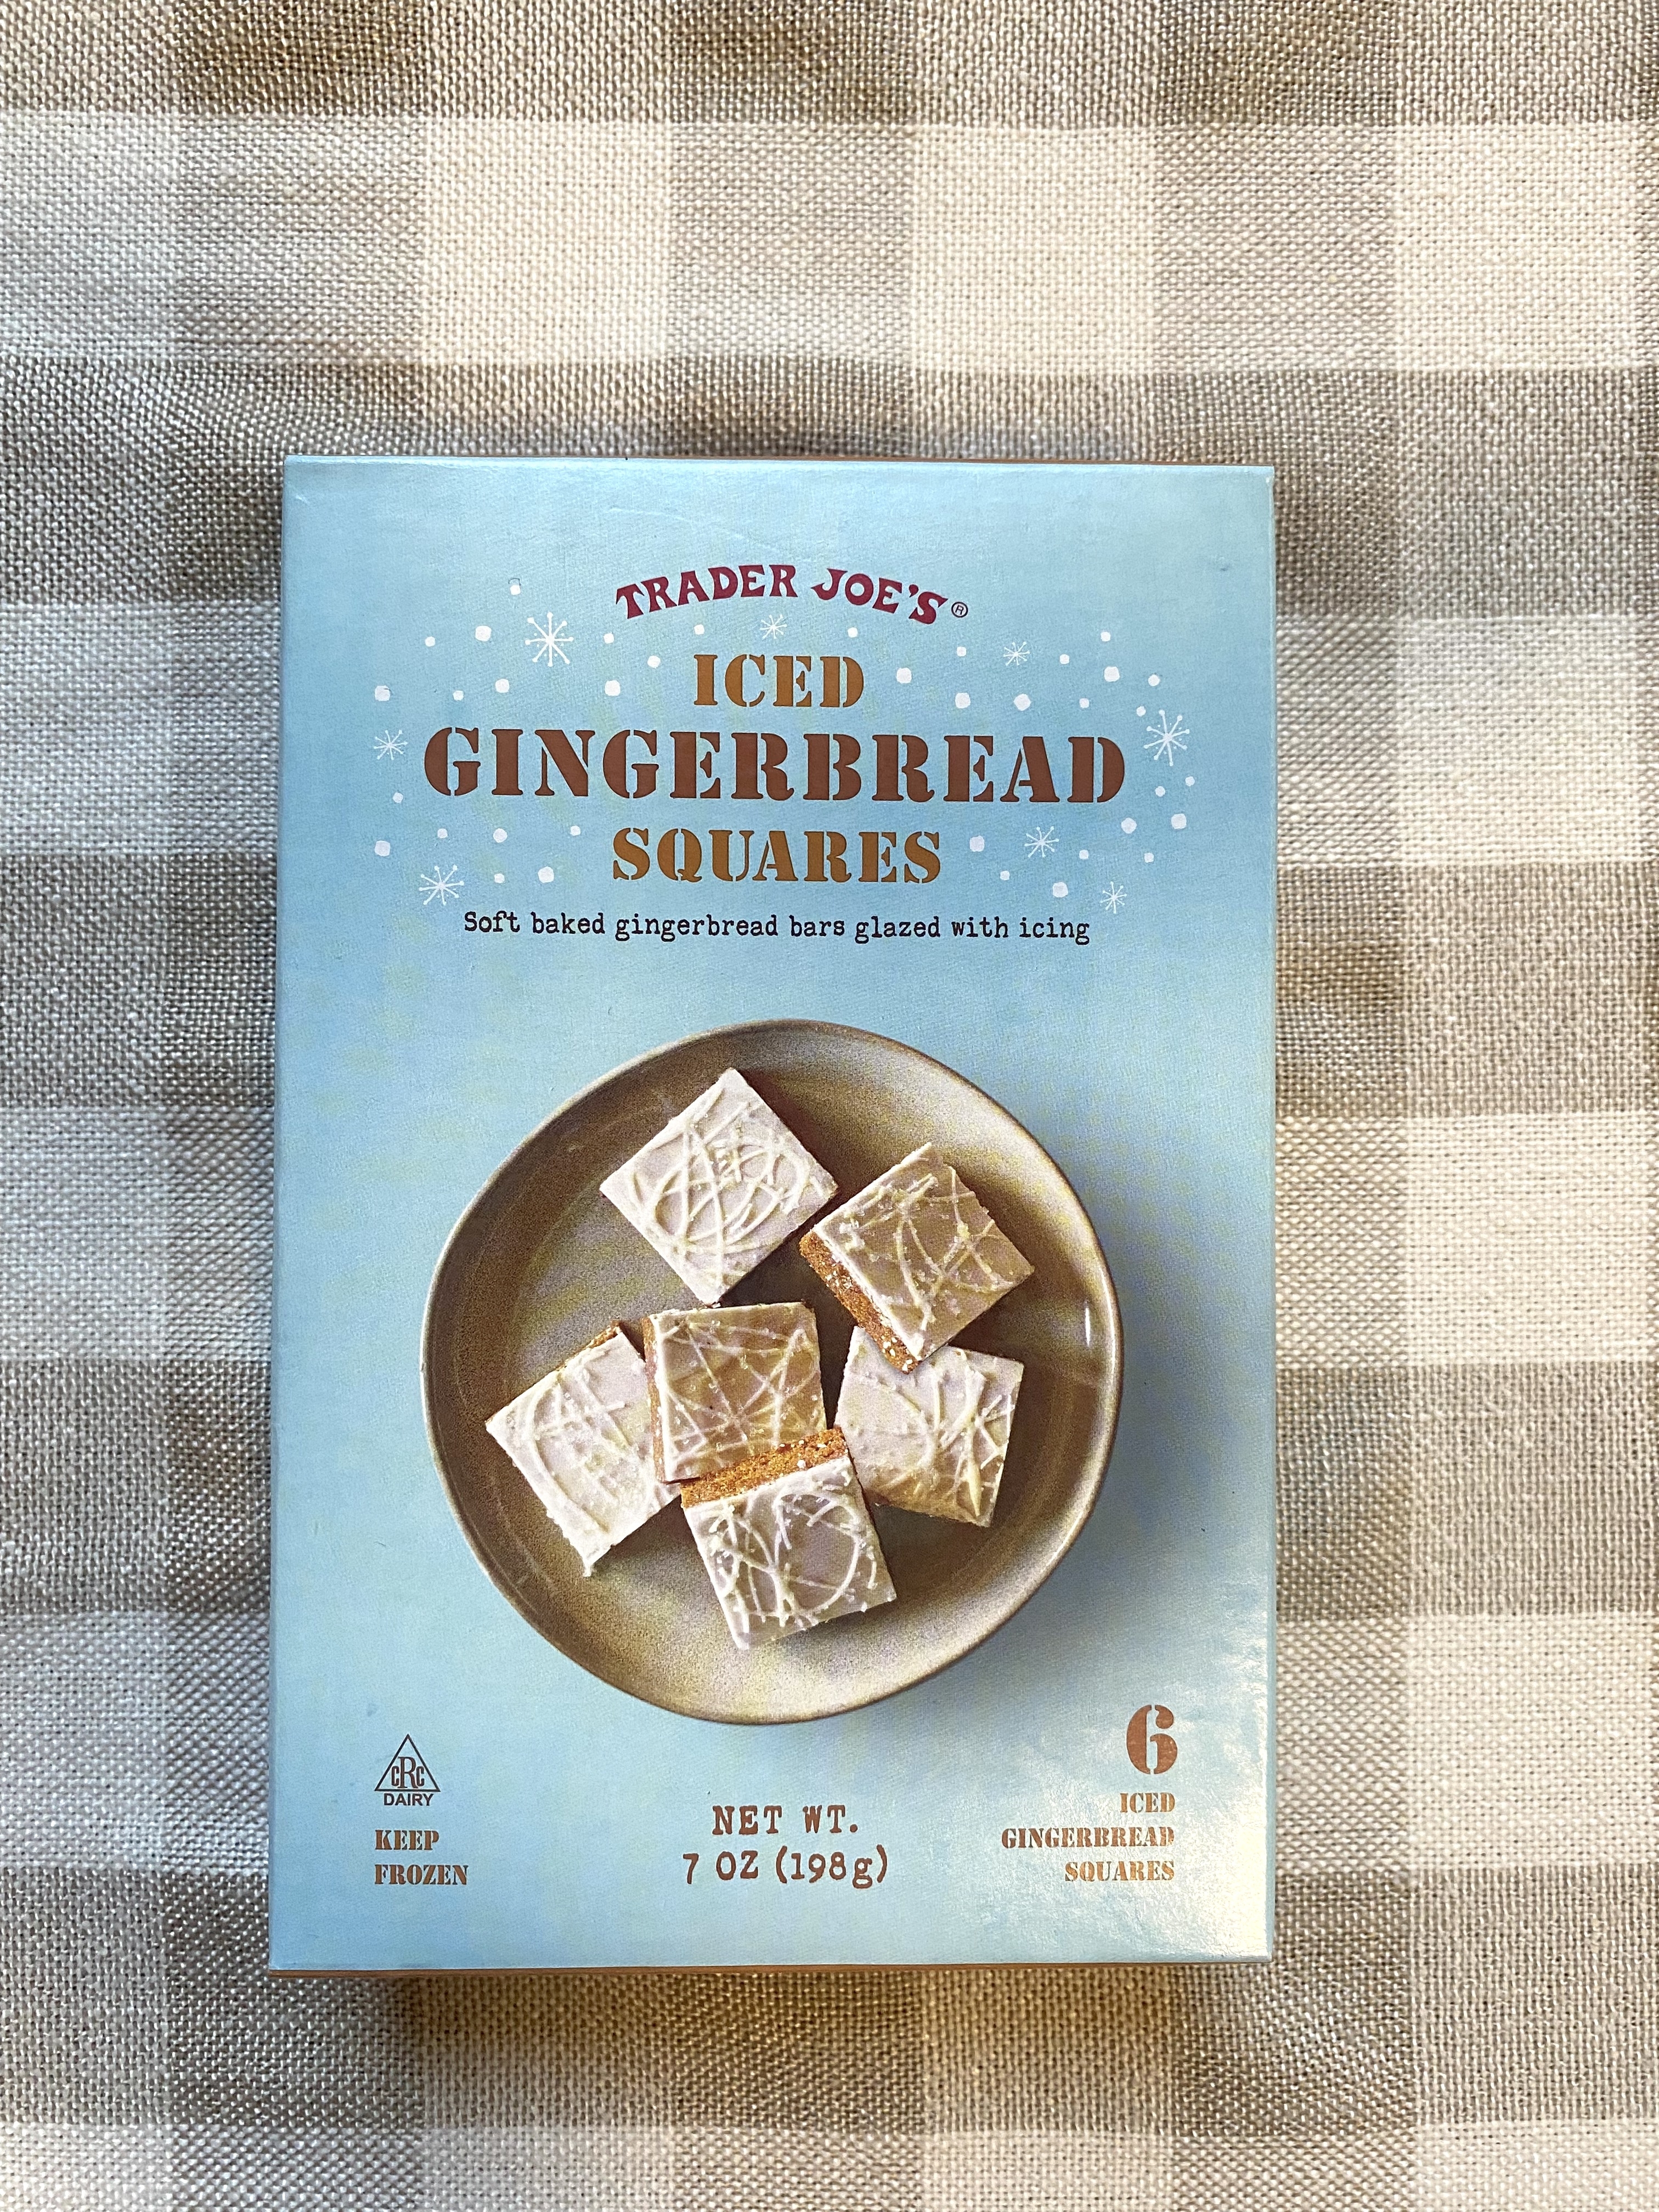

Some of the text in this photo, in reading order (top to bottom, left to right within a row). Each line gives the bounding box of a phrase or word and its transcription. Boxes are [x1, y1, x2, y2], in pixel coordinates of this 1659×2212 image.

[616, 564, 798, 619] TRADER
[693, 654, 865, 708] ICED
[424, 727, 1125, 803] GINGERBREAD
[613, 827, 941, 884] SQUARES
[464, 910, 1090, 945] Soft baked gingerbread bars glazed with icing
[1126, 1704, 1178, 1775] 6
[383, 1793, 434, 1807] DAIRY
[1120, 1792, 1175, 1814] ICED
[712, 1804, 858, 1836] NET WT.
[375, 1830, 439, 1850] KEEP
[1001, 1826, 1175, 1849] GINGERBREAD
[374, 1864, 469, 1886] FROZEN
[682, 1844, 888, 1889] 7 OZ (198g)
[1065, 1860, 1175, 1882] SQUARES
